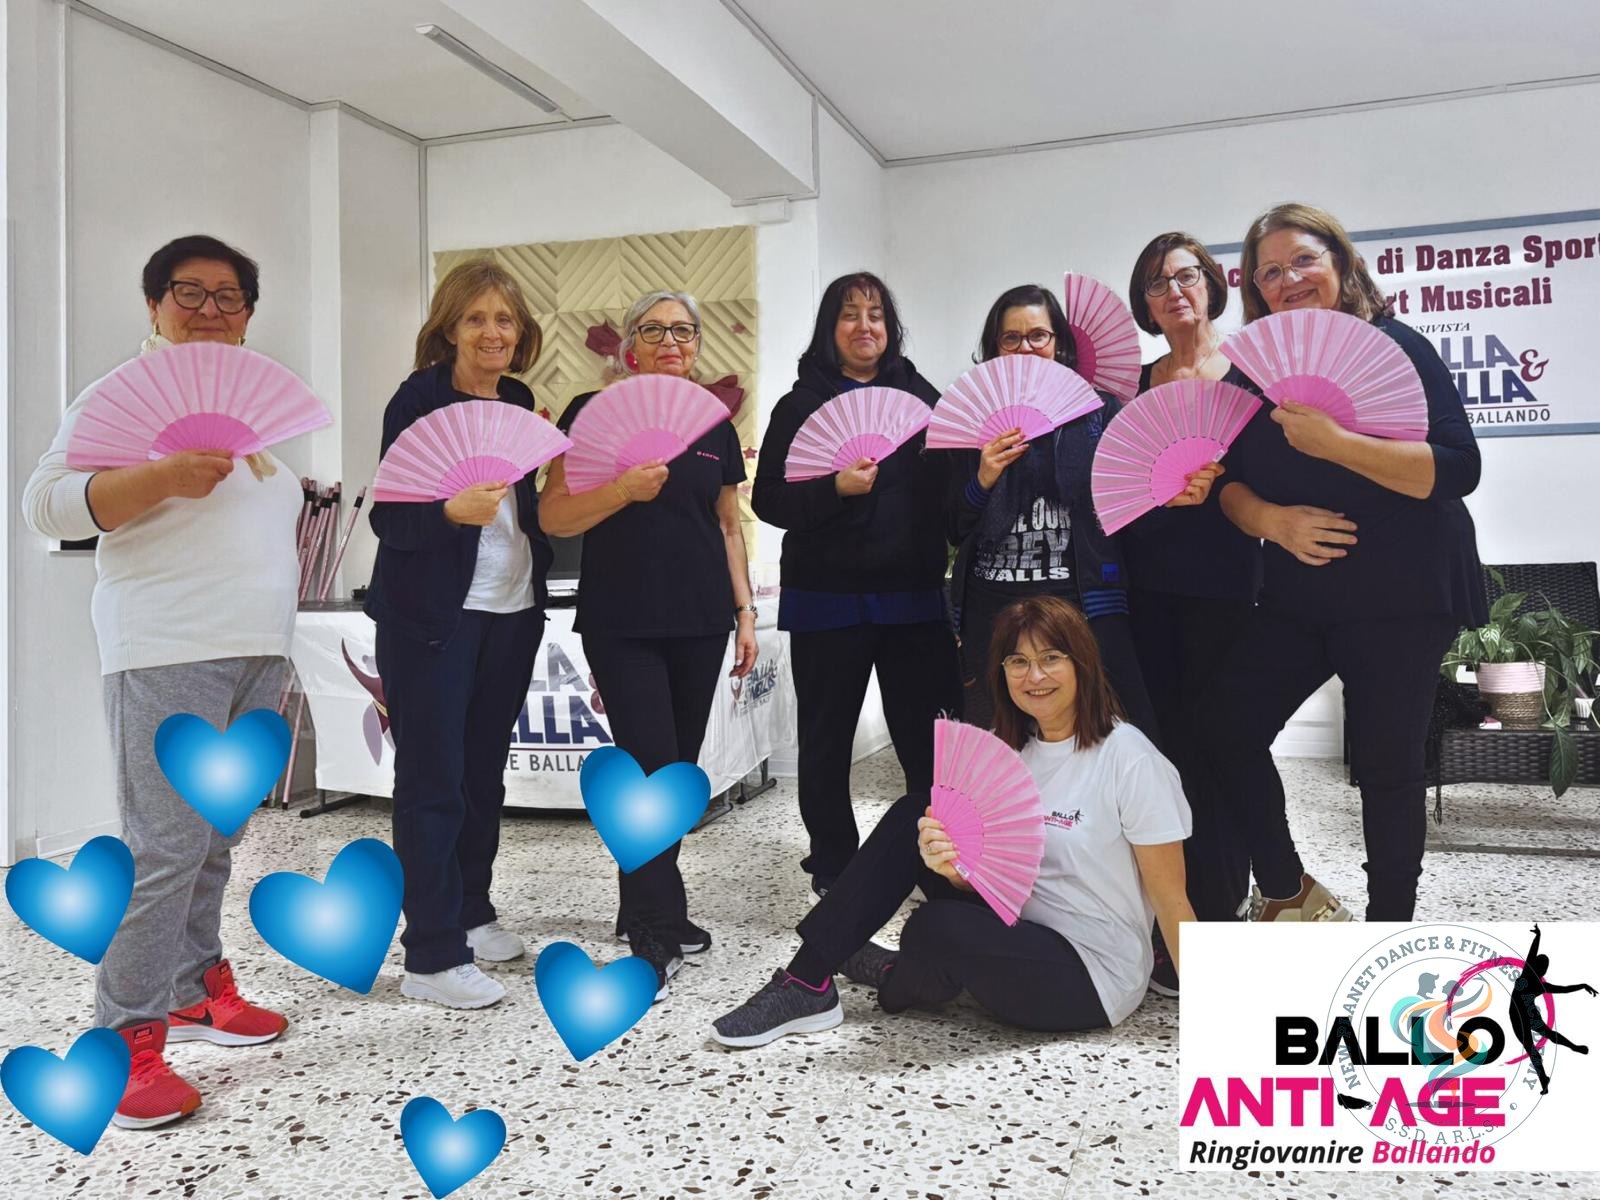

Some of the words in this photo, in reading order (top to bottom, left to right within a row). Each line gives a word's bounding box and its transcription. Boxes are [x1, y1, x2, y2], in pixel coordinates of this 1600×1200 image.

[1377, 247, 1404, 274] di
[1416, 243, 1510, 272] Danza
[1522, 234, 1600, 268] Spor
[1421, 277, 1553, 313] Musicali
[1441, 334, 1520, 370] LLA
[1519, 348, 1549, 382] &
[1452, 369, 1537, 405] LLA
[1032, 496, 1071, 531] OUR
